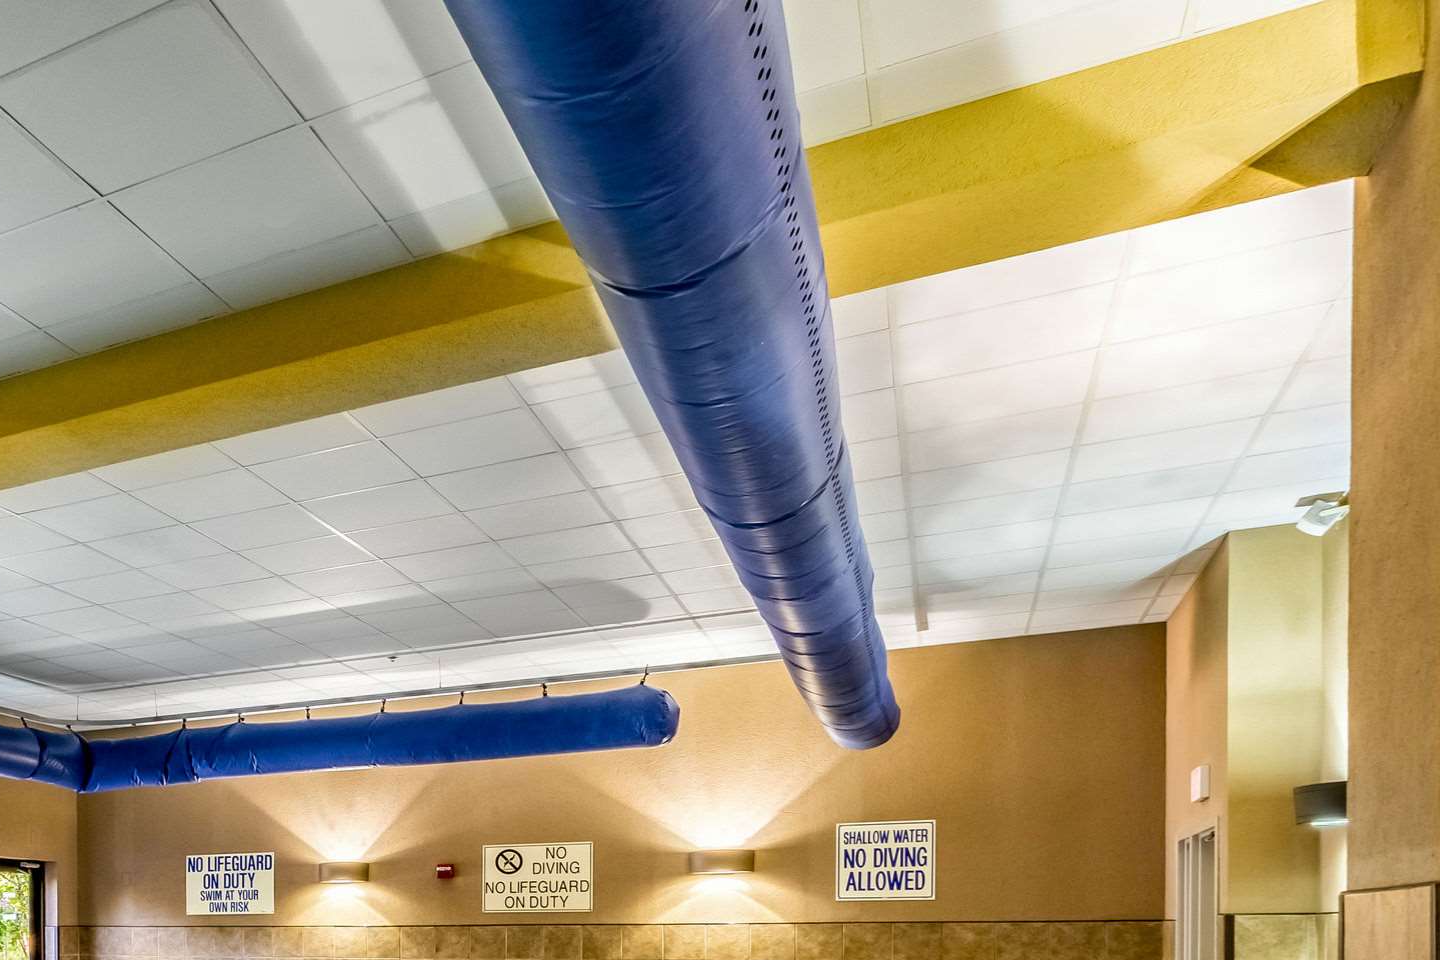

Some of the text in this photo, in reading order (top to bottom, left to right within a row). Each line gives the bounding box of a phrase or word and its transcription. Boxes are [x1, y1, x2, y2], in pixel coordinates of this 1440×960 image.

[843, 829, 928, 845] SHALLOW WATER
[545, 846, 567, 859] NO
[843, 847, 928, 869] NO DIVING
[187, 854, 273, 872] NO LIFEGUARD
[532, 861, 580, 875] DIVING
[203, 872, 255, 889] ON DUTY
[485, 880, 590, 894] NO LIFEGUARD
[845, 870, 925, 892] ALLOWED
[200, 889, 259, 901] SWIM AT YOUR
[504, 895, 569, 909] ON DUTY
[209, 901, 249, 912] OWN RISK
